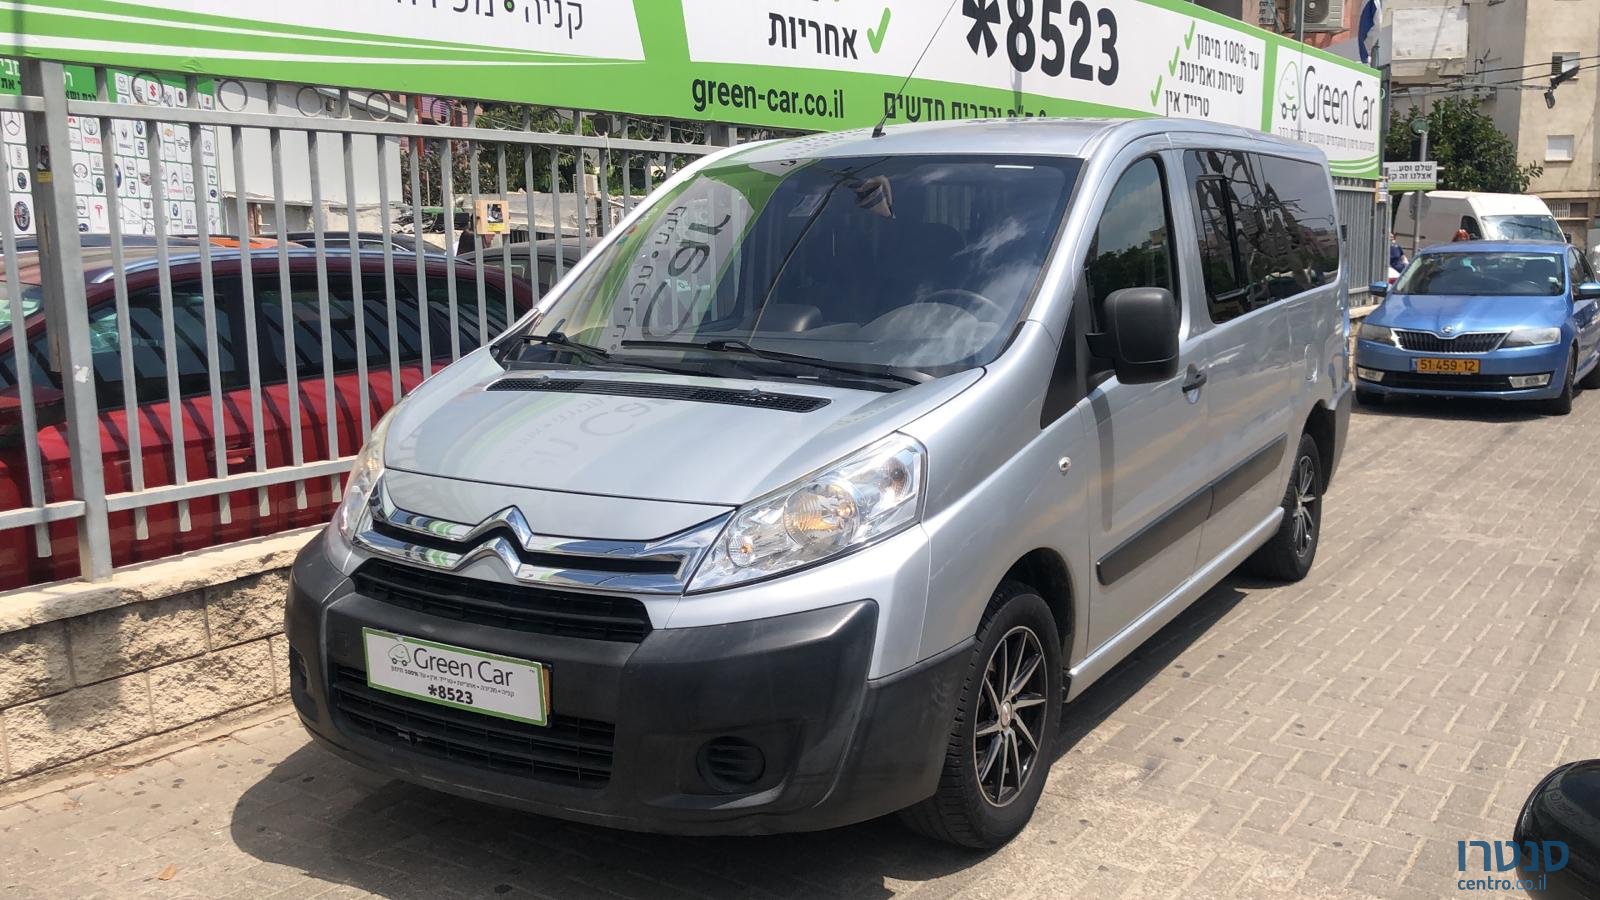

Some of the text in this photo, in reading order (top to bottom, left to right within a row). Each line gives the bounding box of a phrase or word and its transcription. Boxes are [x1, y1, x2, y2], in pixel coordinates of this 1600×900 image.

[768, 12, 858, 60] אחריות
[1197, 34, 1260, 71] עד 100% מימון
[1179, 60, 1244, 95] שירות ואמינות
[692, 78, 844, 119] green-car.co.il
[1165, 90, 1210, 117] טרייד אין
[1304, 65, 1375, 131] Green Car
[414, 647, 513, 687] Green Car
